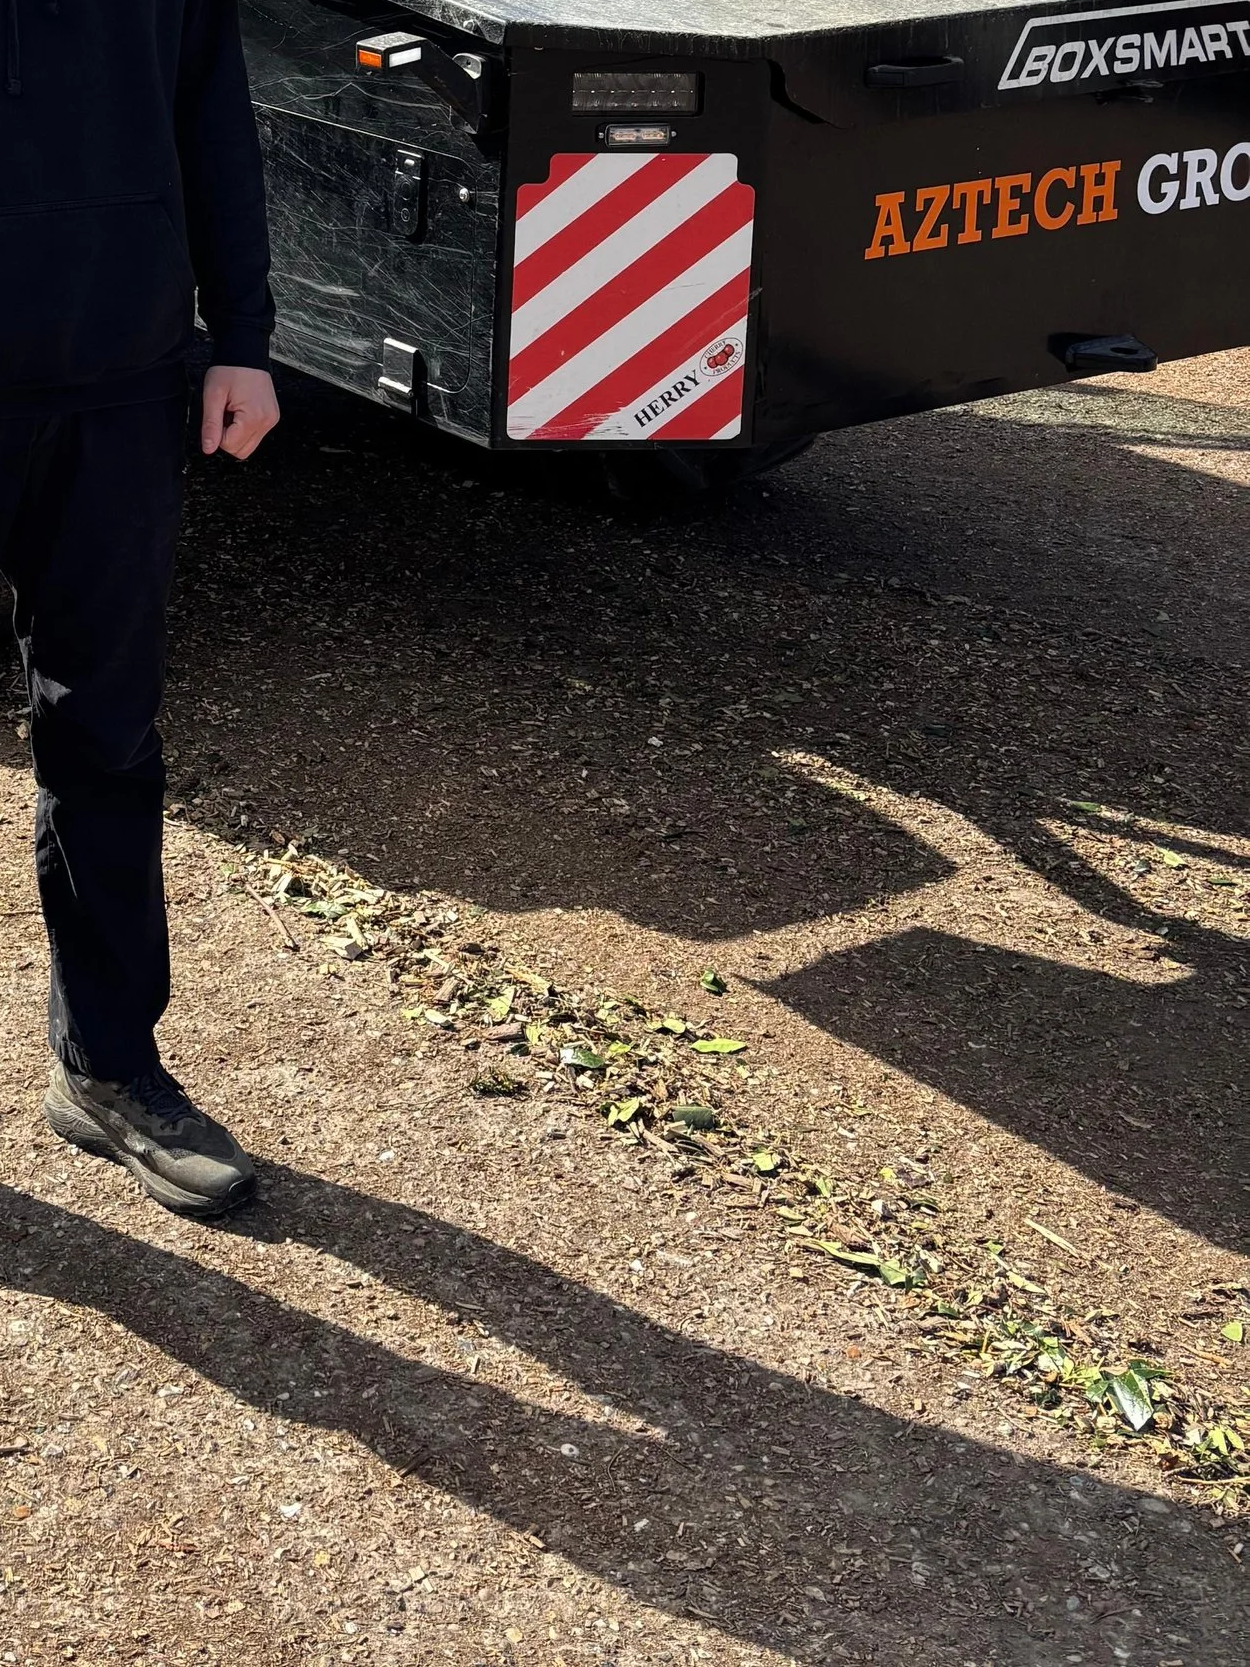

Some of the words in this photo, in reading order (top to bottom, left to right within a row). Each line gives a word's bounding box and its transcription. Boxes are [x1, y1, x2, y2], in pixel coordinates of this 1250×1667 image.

[1018, 20, 1250, 86] BOXSMART
[864, 159, 1122, 260] AZTECH
[1136, 142, 1250, 215] GRO
[633, 369, 700, 428] HERRY
